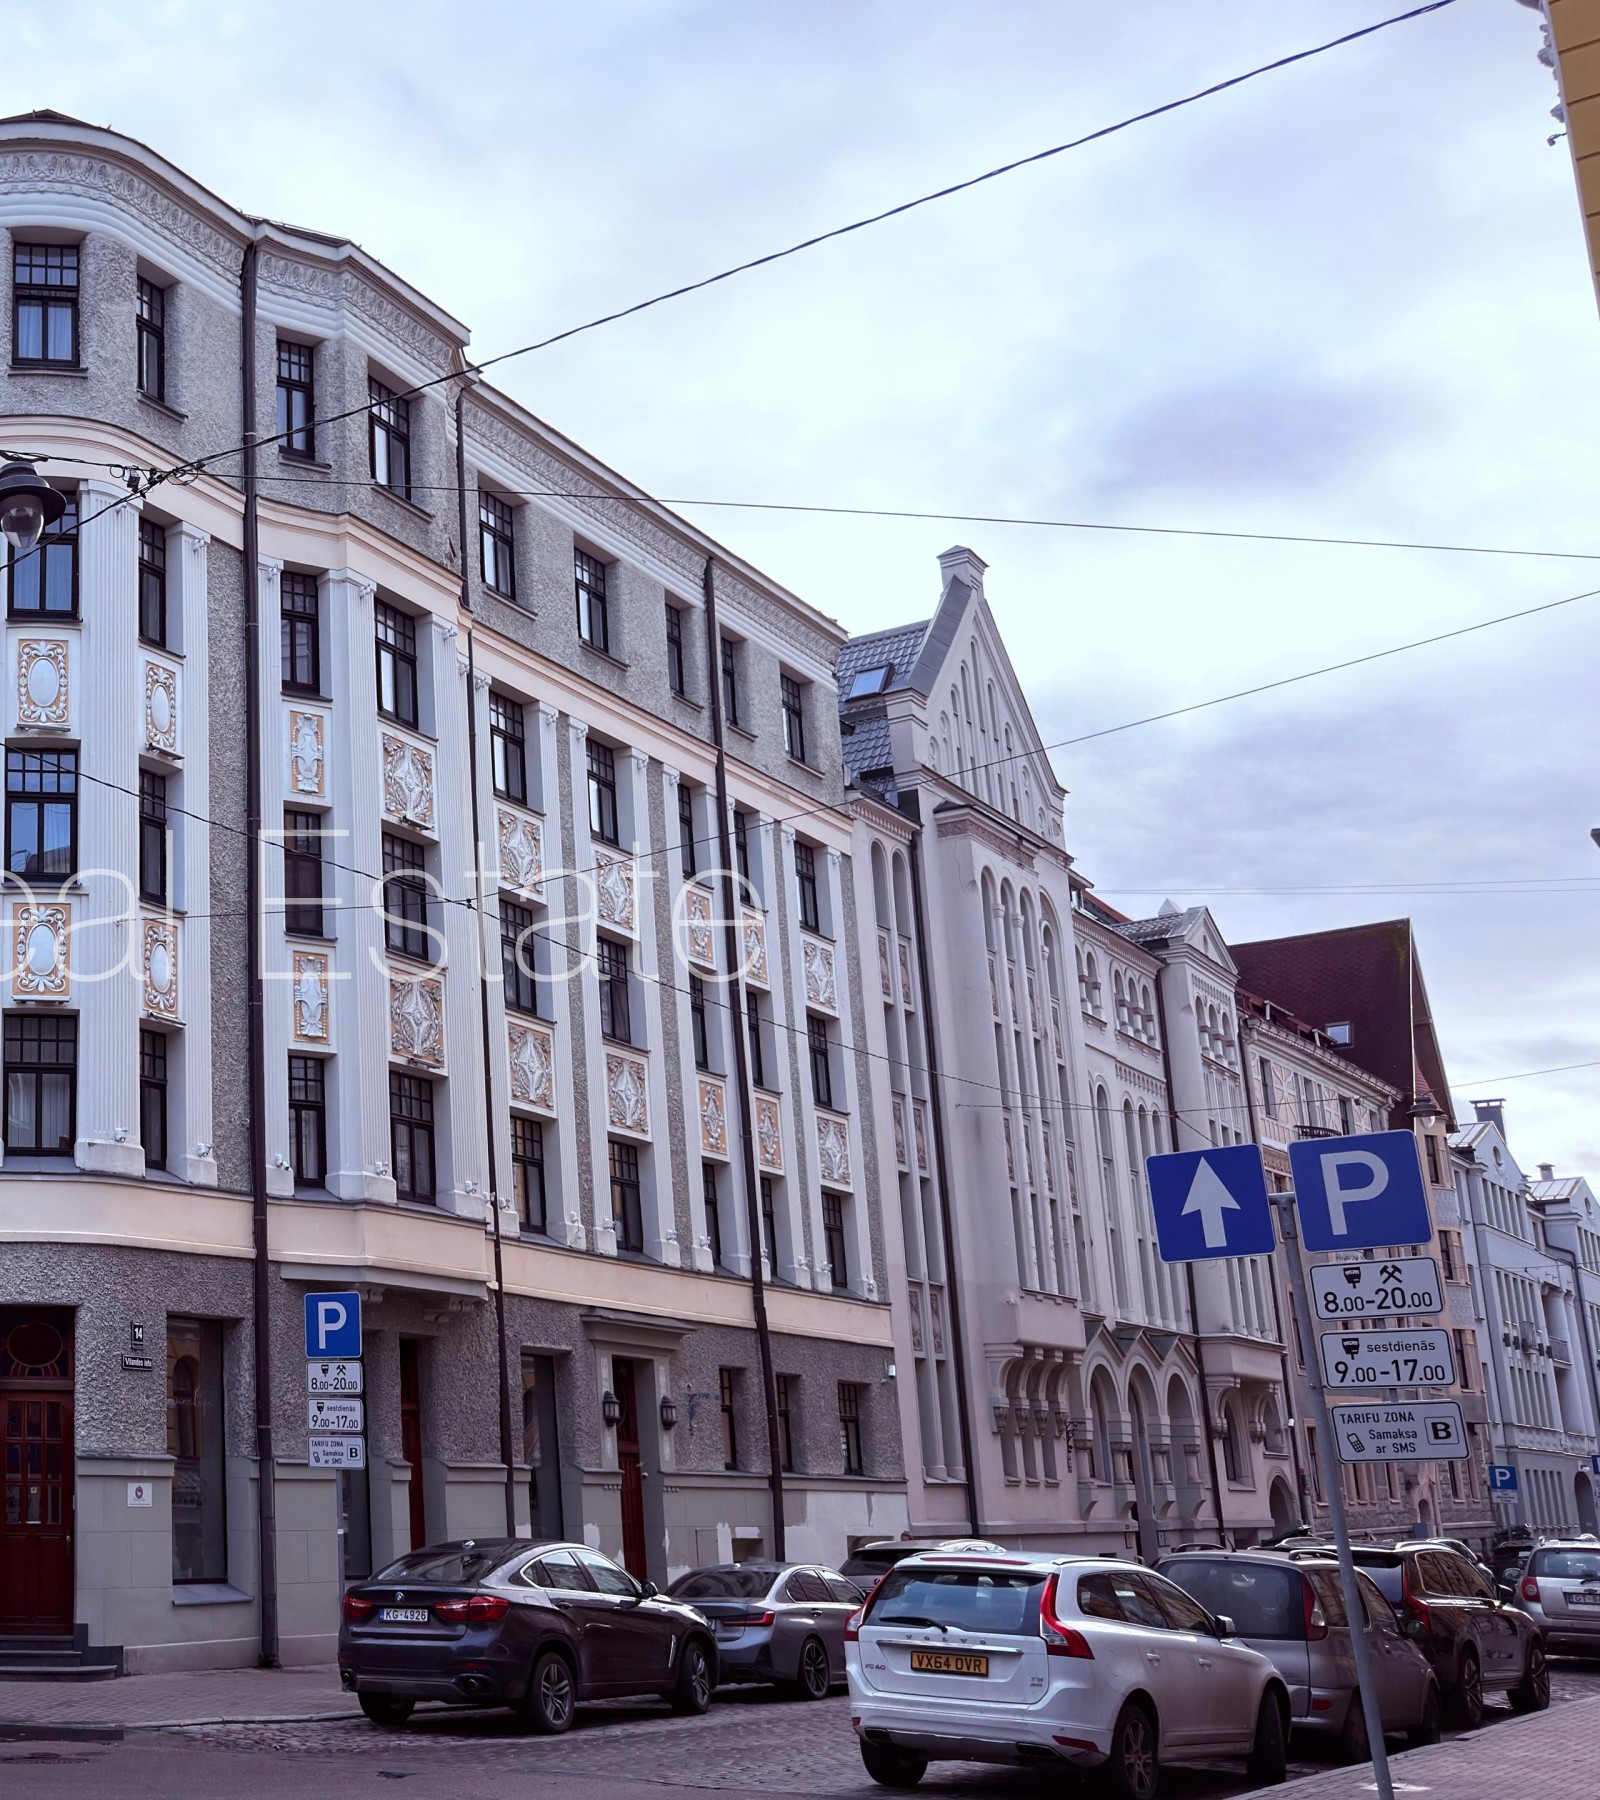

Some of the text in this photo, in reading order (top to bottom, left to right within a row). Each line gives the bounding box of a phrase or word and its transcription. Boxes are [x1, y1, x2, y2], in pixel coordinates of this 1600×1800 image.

[1320, 1150, 1389, 1236] P
[1323, 1287, 1433, 1313] 8.00-20.00
[317, 1301, 347, 1350] P
[134, 1327, 143, 1339] 14
[1366, 1340, 1436, 1353] sestdienās
[311, 1377, 358, 1390] 8.00-20.00
[1339, 1411, 1415, 1425] TARIFU ZONA
[1368, 1429, 1418, 1440] Samaksa
[1431, 1421, 1451, 1440] B
[322, 1449, 344, 1457] Samaksa
[349, 1447, 358, 1458] B
[1375, 1442, 1416, 1454] ar SMS
[1494, 1468, 1511, 1487] P
[385, 1609, 427, 1620] KG-4926
[905, 1635, 986, 1645] VOLVO
[916, 1654, 982, 1672] VX64 OVR
